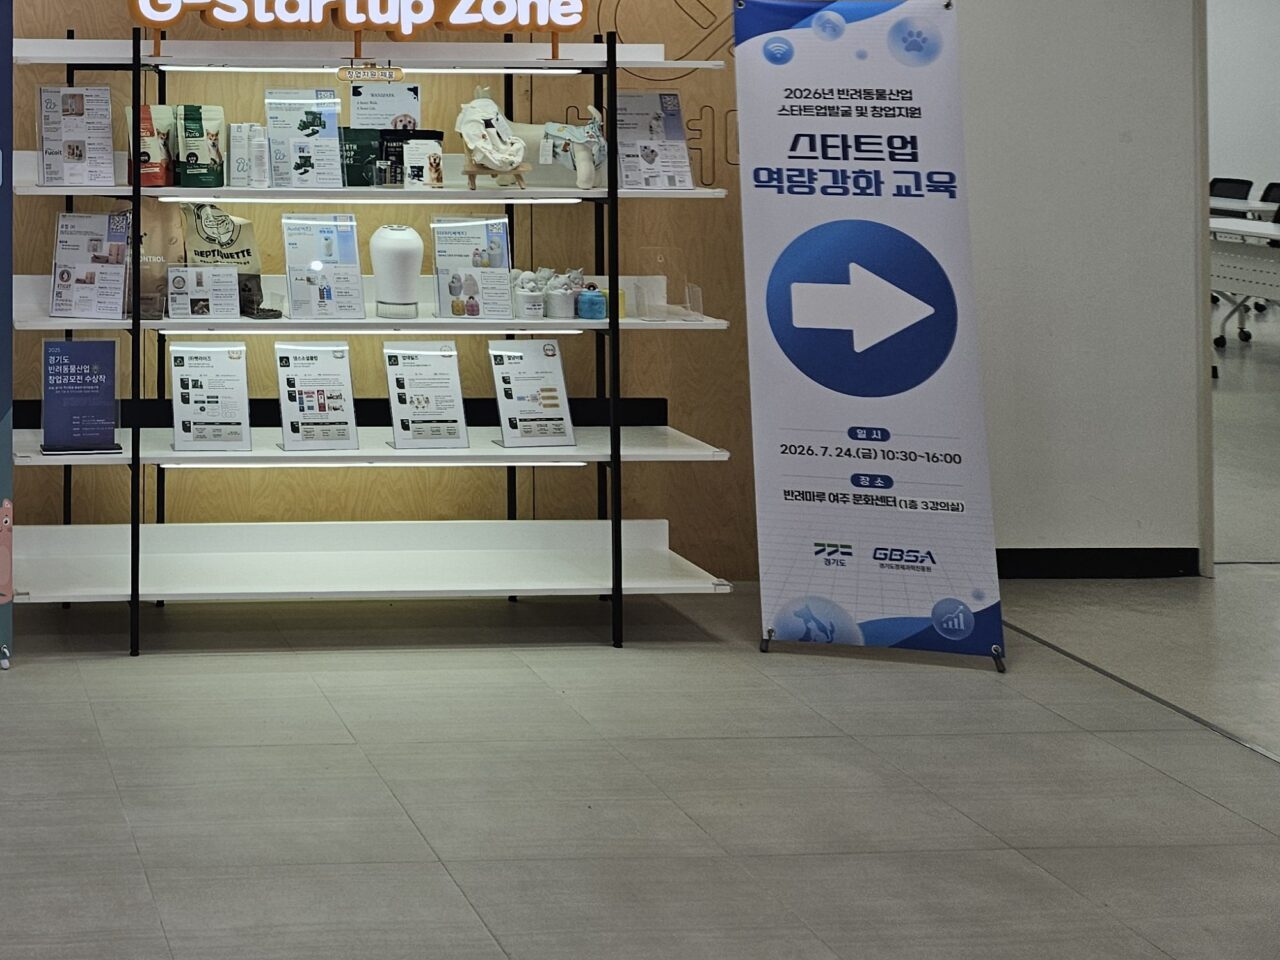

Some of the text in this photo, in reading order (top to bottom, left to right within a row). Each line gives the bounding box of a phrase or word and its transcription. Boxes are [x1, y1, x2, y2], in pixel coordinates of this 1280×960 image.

[783, 88, 913, 101] 2026년 반려동물산업
[777, 106, 922, 119] 스타트업발굴 및 창업지원
[787, 133, 919, 162] 스타트업
[753, 167, 957, 199] 역량강화 교육
[48, 355, 70, 364] 경기도
[780, 444, 818, 456] 2026.
[821, 446, 832, 458] 7.
[881, 449, 962, 464] 10:30~16:00
[783, 489, 965, 512] 반려마루 여주 문화센터 (1층 3강의실)
[823, 558, 846, 567] 경기도
[873, 547, 936, 564] GBSA
